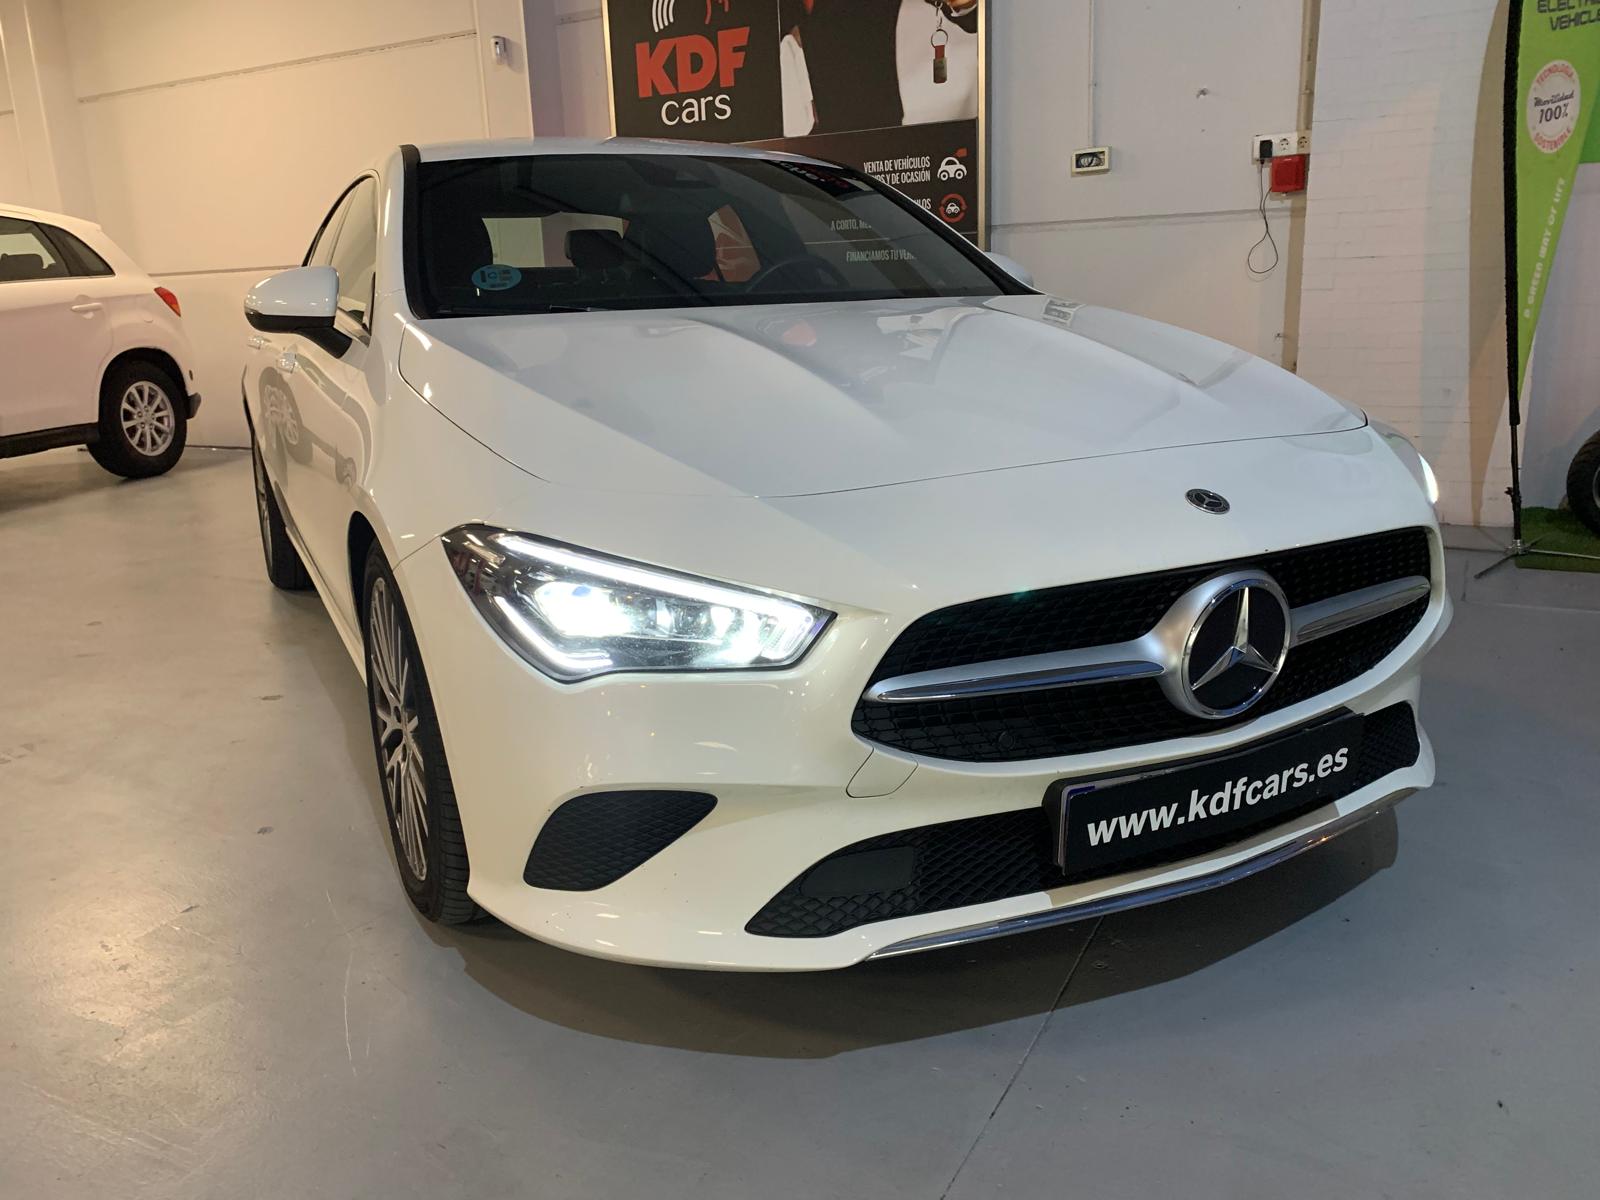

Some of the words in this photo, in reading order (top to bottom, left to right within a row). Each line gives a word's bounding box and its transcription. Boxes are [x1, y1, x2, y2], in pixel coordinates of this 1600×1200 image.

[635, 26, 750, 98] KDF
[660, 93, 732, 126] cars
[1538, 102, 1569, 124] 100%
[863, 161, 884, 174] VENTA
[884, 159, 894, 172] DE
[894, 155, 931, 170] VEHÍCULOS
[891, 172, 901, 185] DE
[900, 168, 931, 183] OCASIÓN
[1086, 747, 1349, 847] www.kdfcars.es
